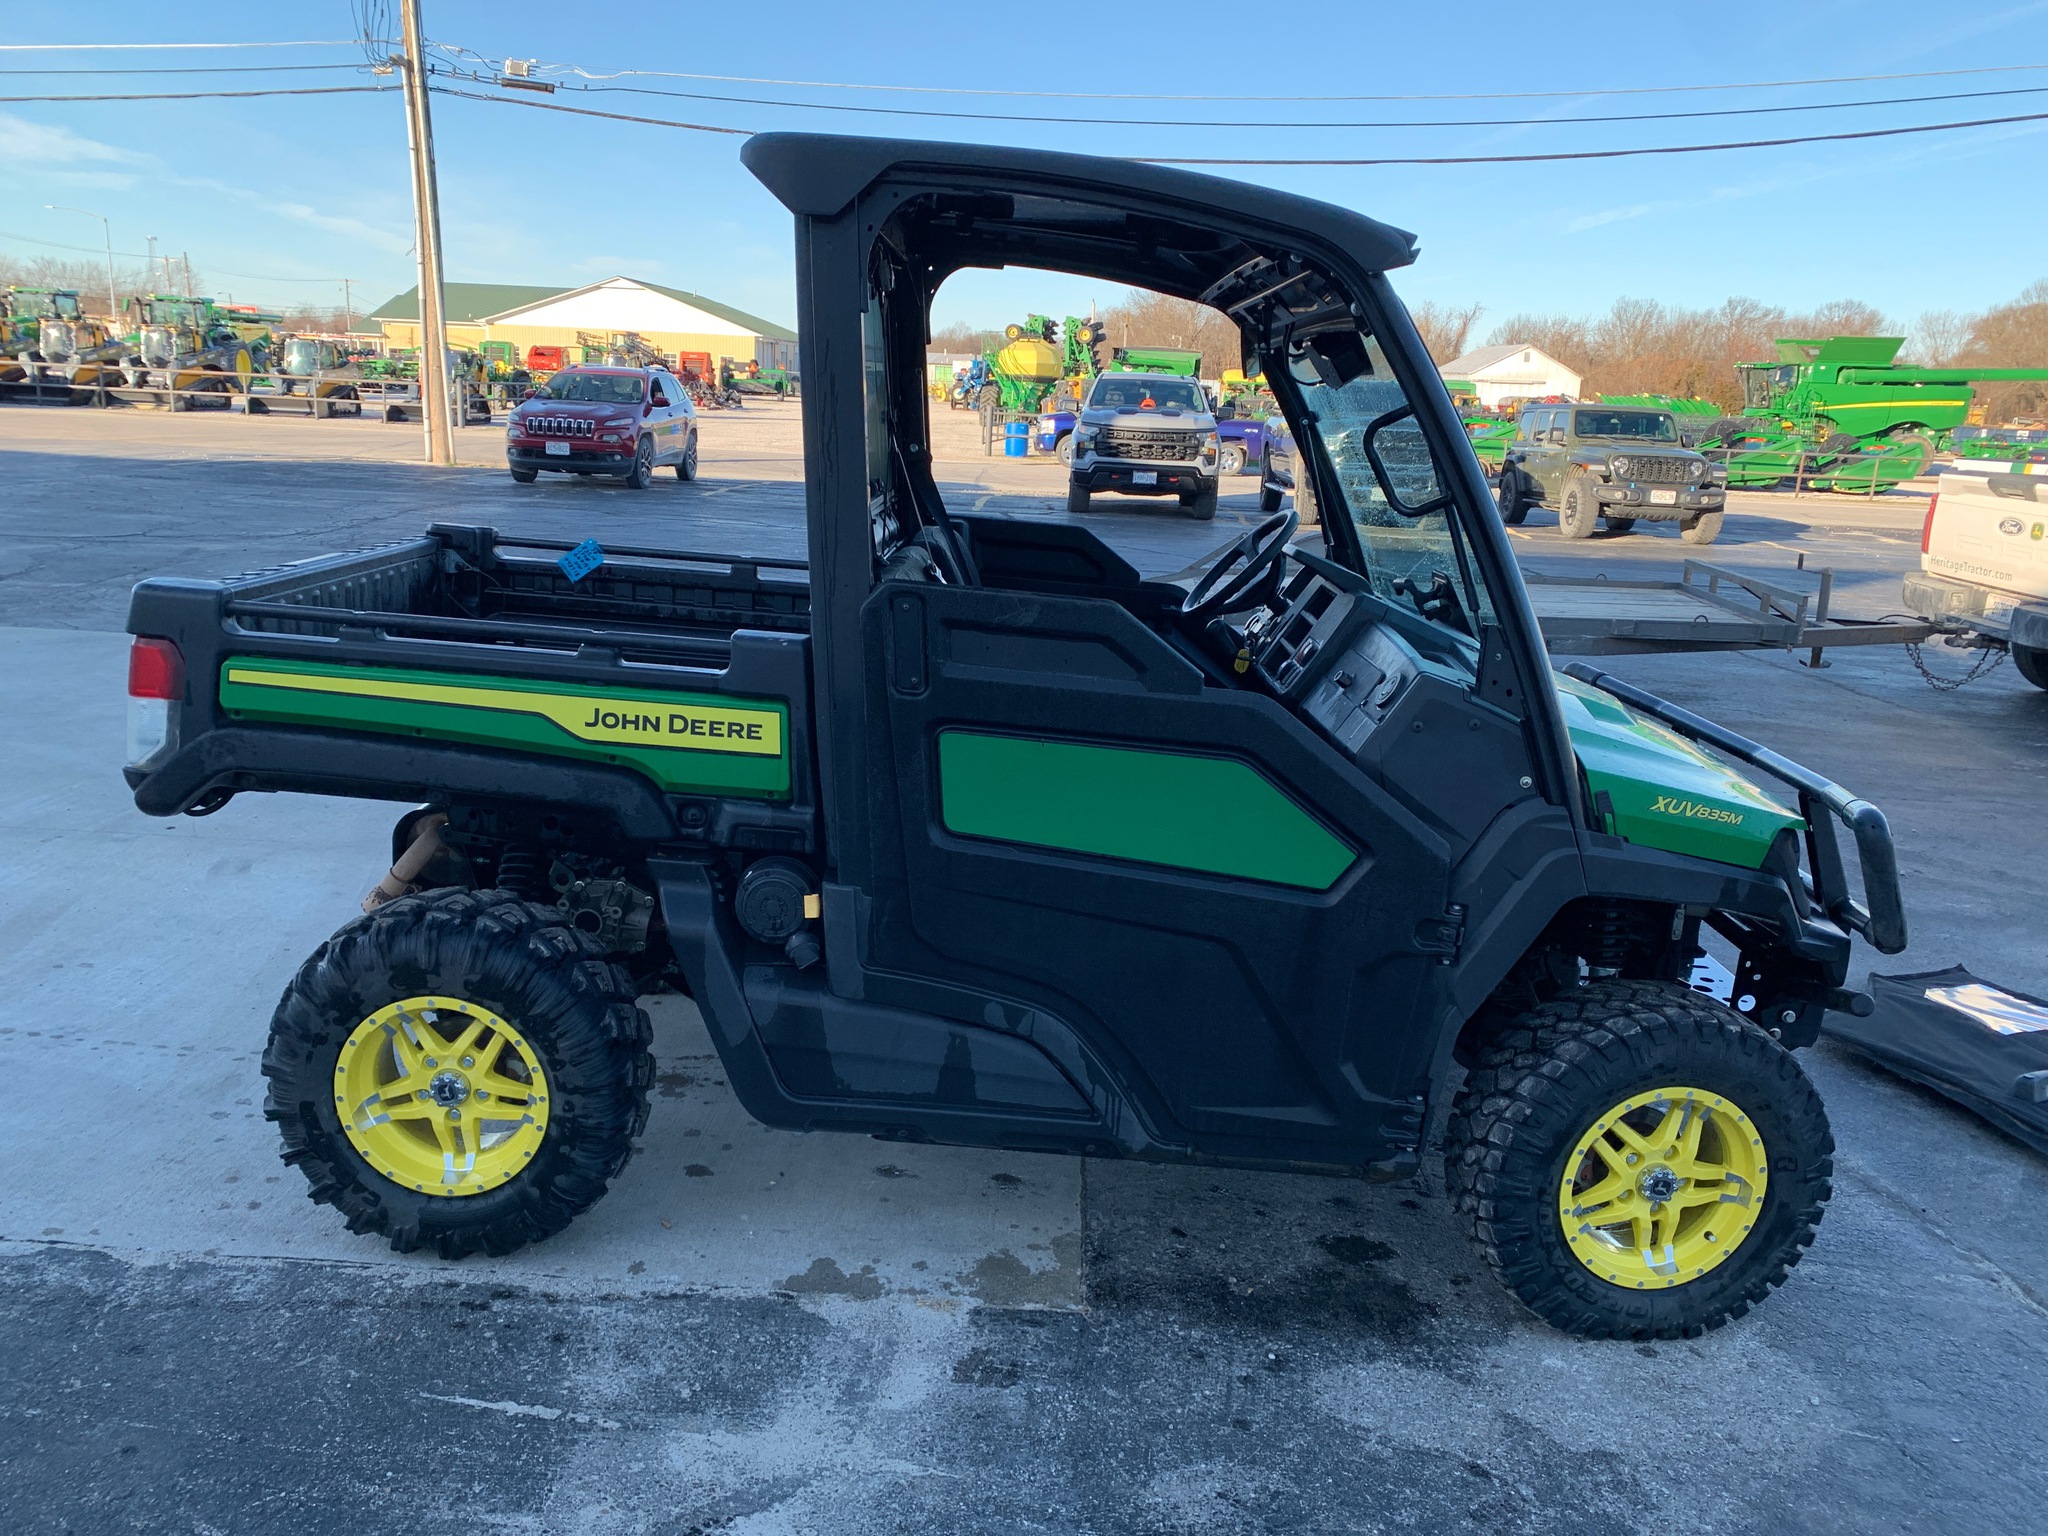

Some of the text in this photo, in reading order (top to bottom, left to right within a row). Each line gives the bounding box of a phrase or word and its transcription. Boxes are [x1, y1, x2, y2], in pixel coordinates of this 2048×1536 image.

[2001, 521, 2020, 534] Ford
[1930, 555, 2013, 582] HeritageTractor.com
[584, 707, 763, 741] JOHN DEERE
[1649, 795, 1744, 825] XUV835M
